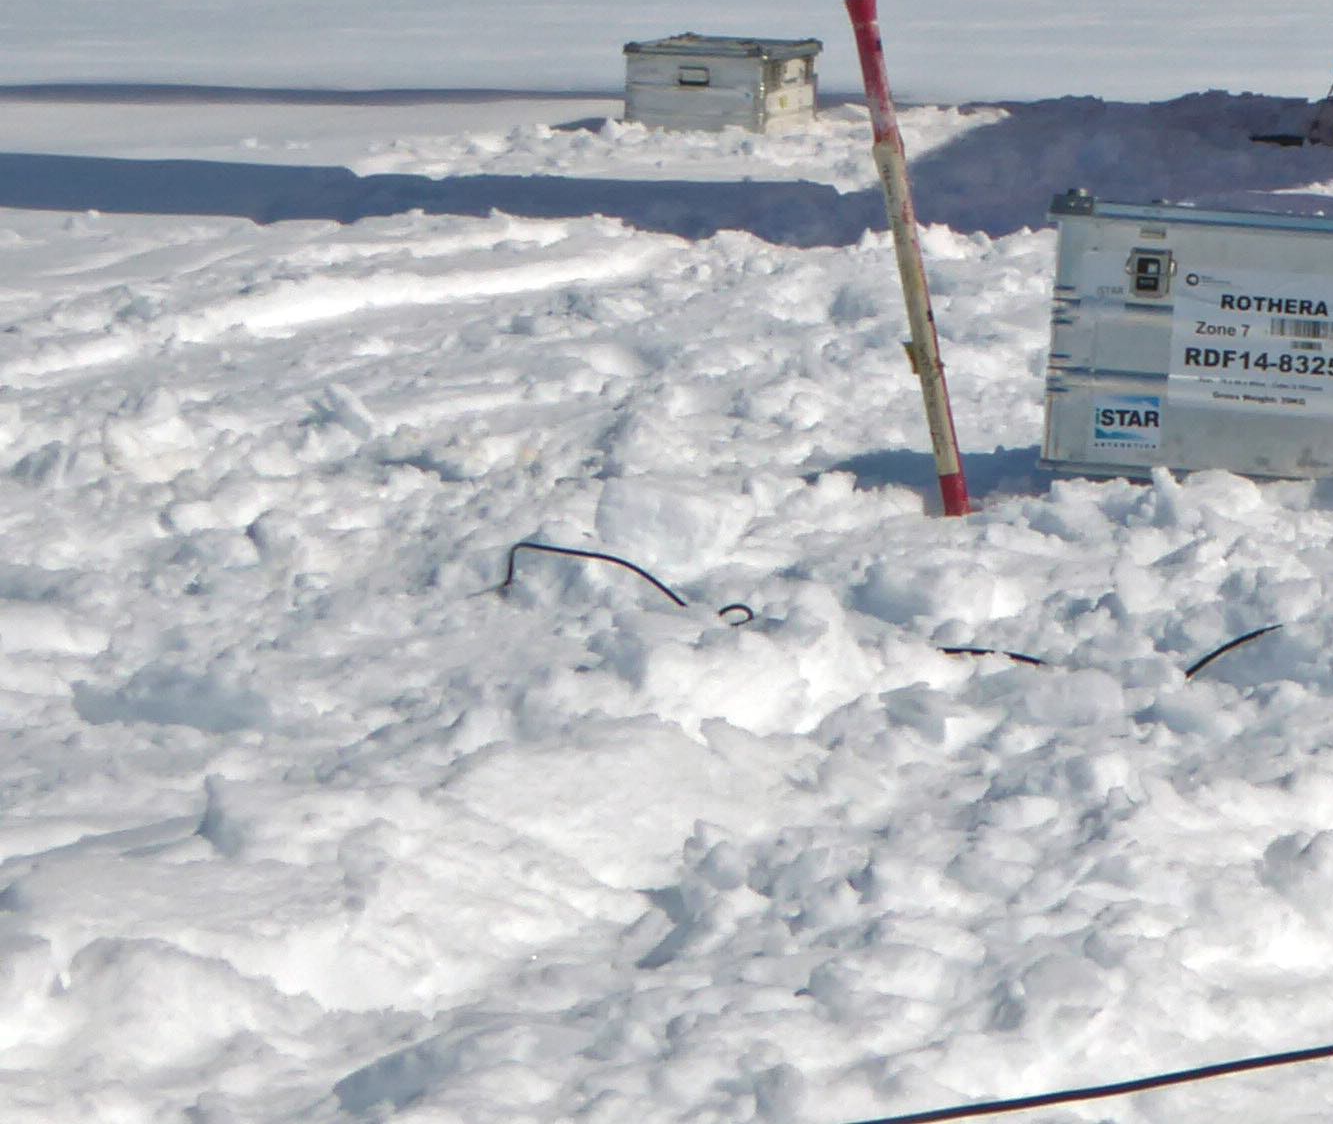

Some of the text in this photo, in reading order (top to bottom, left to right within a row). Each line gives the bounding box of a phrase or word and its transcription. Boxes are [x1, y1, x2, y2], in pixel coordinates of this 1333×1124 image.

[1220, 294, 1329, 316] ROTHERA
[1195, 321, 1251, 337] Zone 7
[1095, 407, 1160, 427] iSTAR
